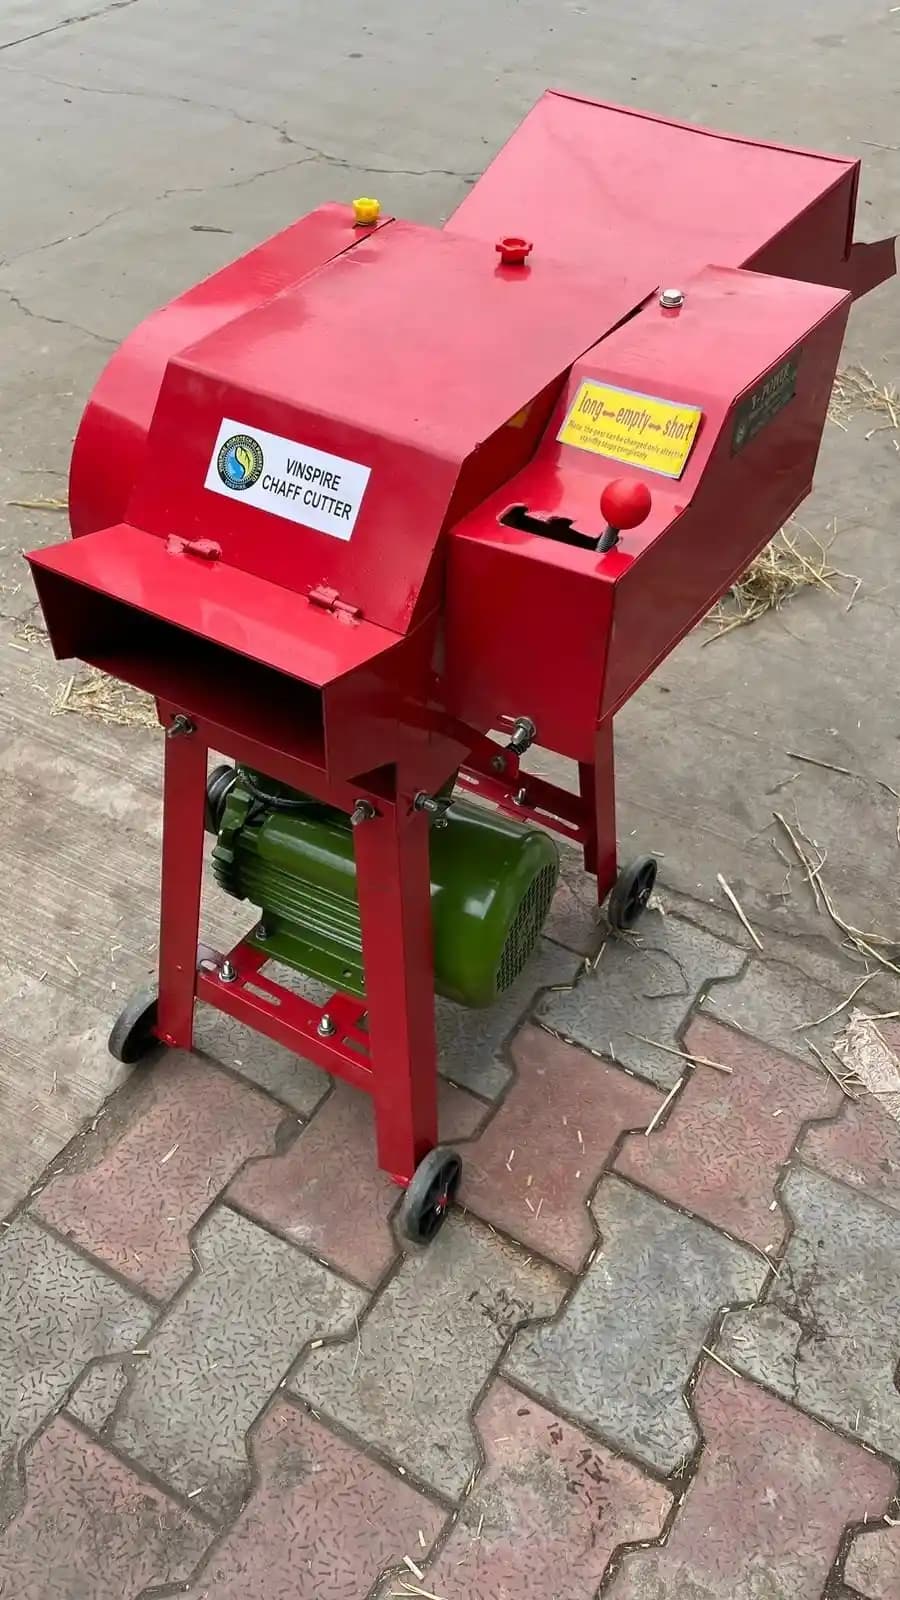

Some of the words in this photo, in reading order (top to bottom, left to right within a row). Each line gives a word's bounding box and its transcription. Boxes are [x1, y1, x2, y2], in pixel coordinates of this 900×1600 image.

[578, 390, 604, 422] long
[615, 407, 651, 435] empty
[663, 415, 693, 441] short
[262, 474, 302, 501] CHAFF
[303, 490, 352, 520] CUTTER
[286, 458, 342, 491] VINSPIRE
